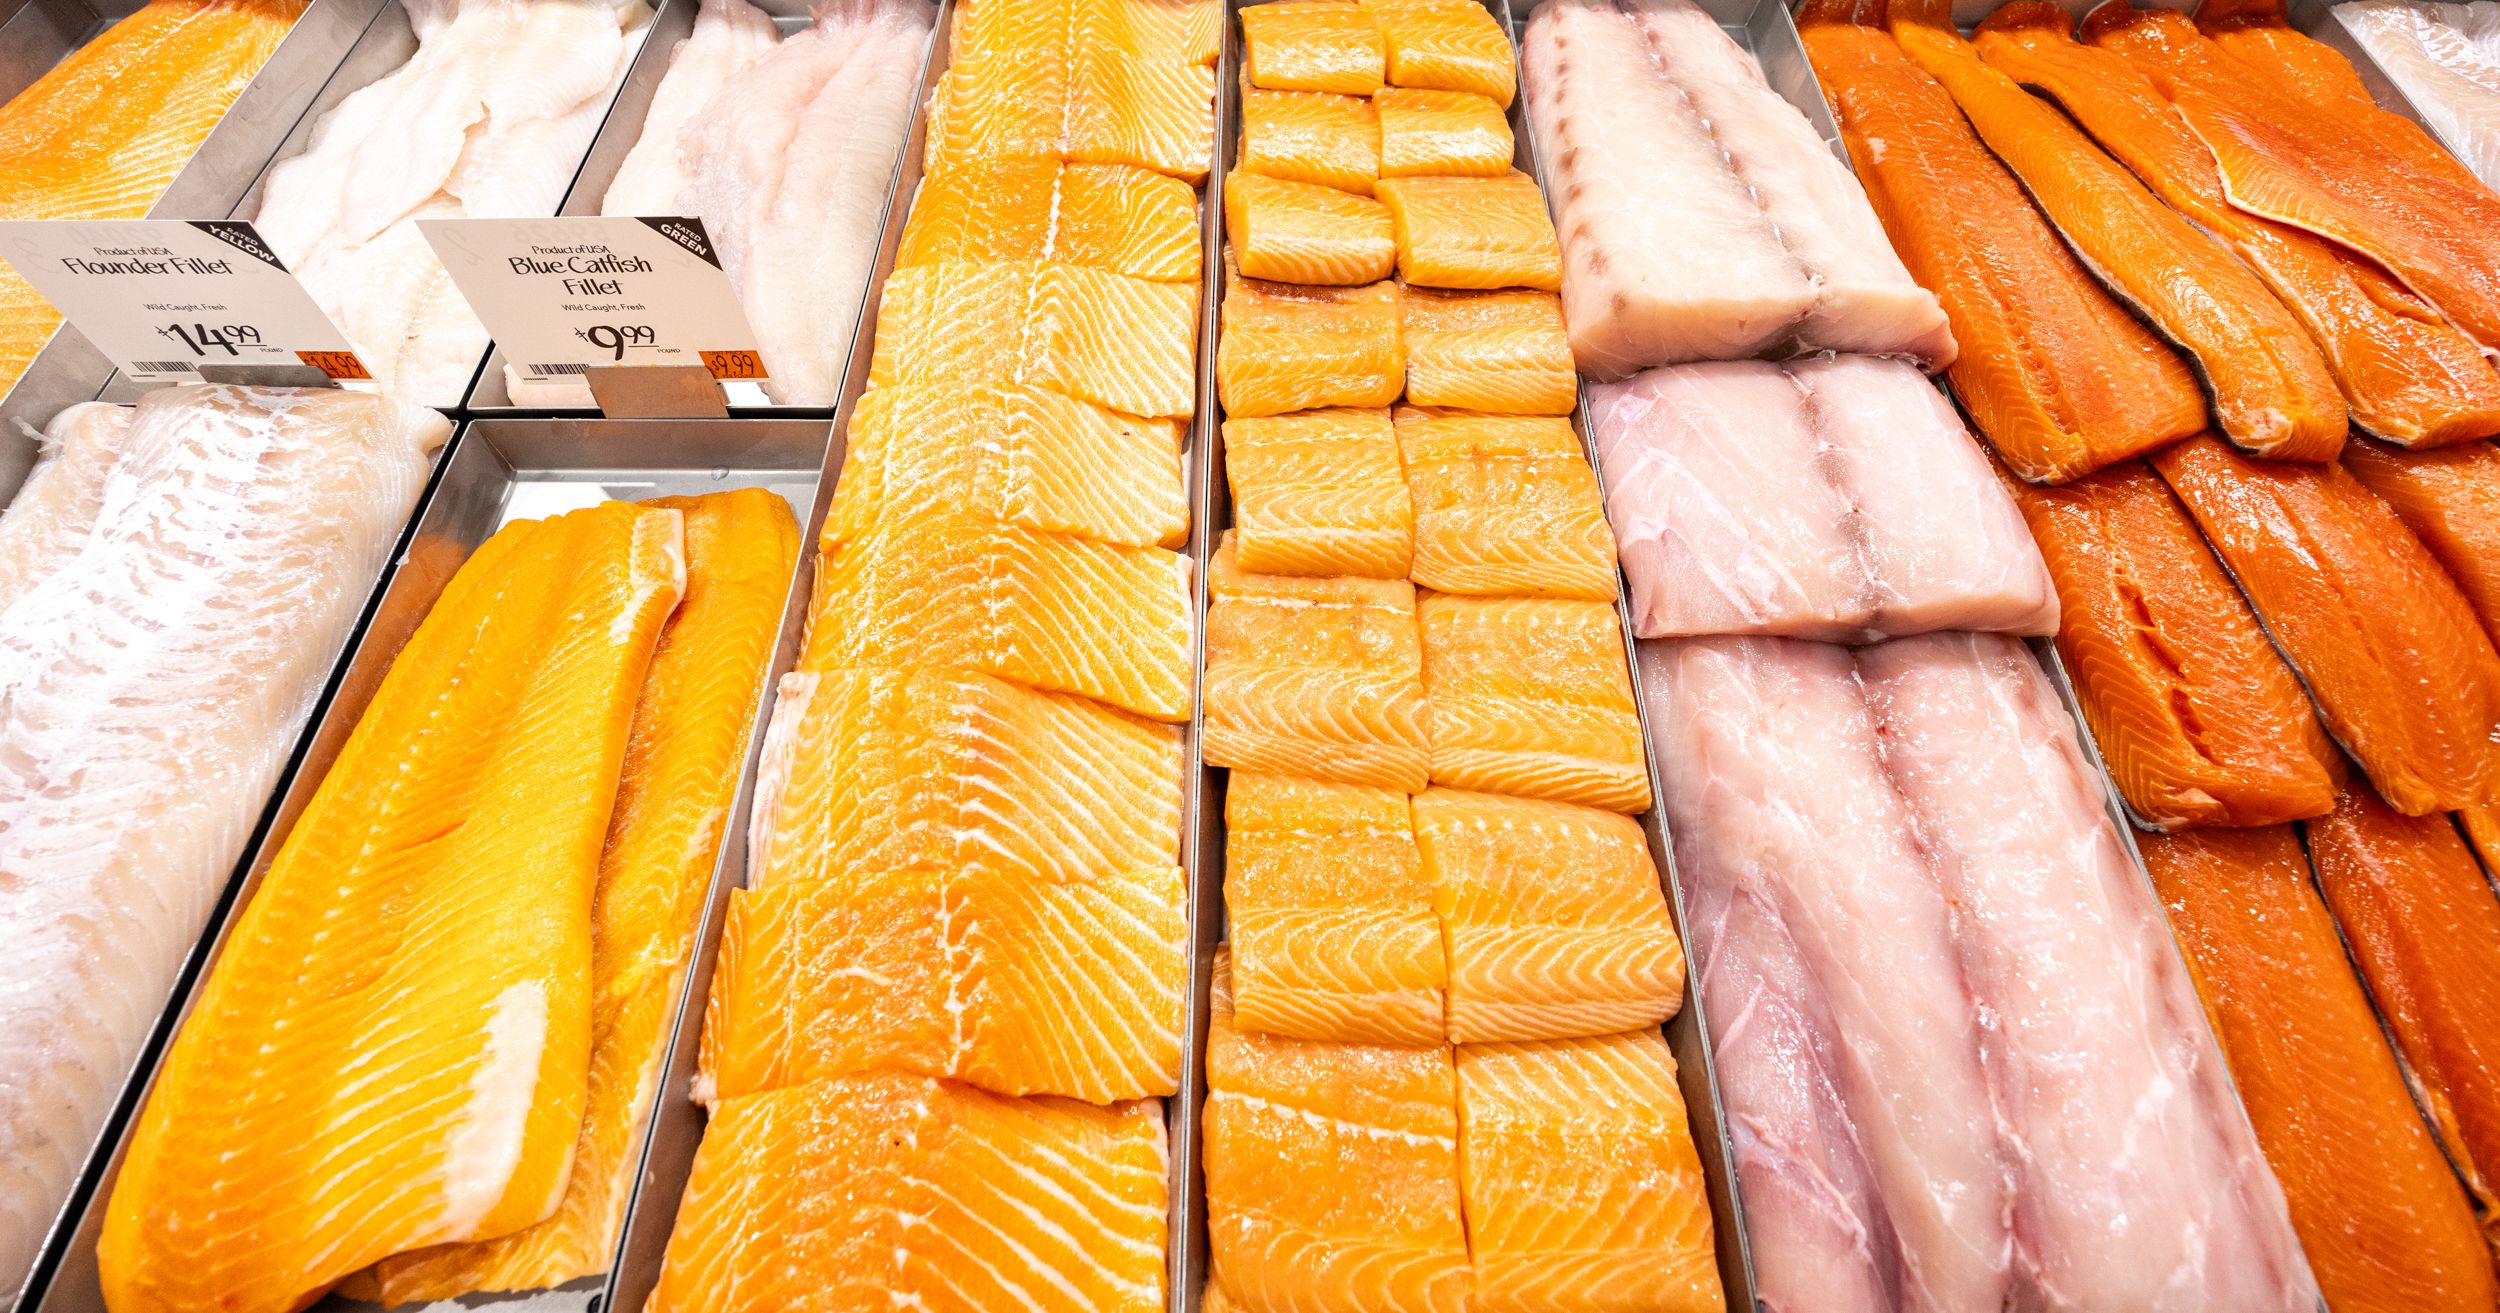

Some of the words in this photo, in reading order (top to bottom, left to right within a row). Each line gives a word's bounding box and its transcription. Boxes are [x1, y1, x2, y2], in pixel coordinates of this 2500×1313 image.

[226, 227, 259, 246] RATED
[660, 223, 707, 256] GREEN
[674, 222, 702, 242] RATED
[93, 247, 137, 255] Product
[147, 247, 174, 255] USA
[208, 224, 275, 262] YELLOW
[531, 246, 574, 255] Product
[575, 244, 586, 254] of
[585, 244, 611, 254] USA
[61, 257, 169, 275] Flounder
[168, 257, 234, 275] Fillet
[508, 256, 567, 275] Blue
[567, 253, 653, 274] Catfish
[562, 278, 624, 296] Fillet
[142, 303, 167, 311] Wild
[166, 303, 203, 312] Caught,
[200, 303, 229, 311] Fresh
[561, 303, 584, 312] Wild
[585, 303, 620, 313] Caught,
[620, 303, 646, 312] Fresh
[711, 354, 754, 376] $9.99
